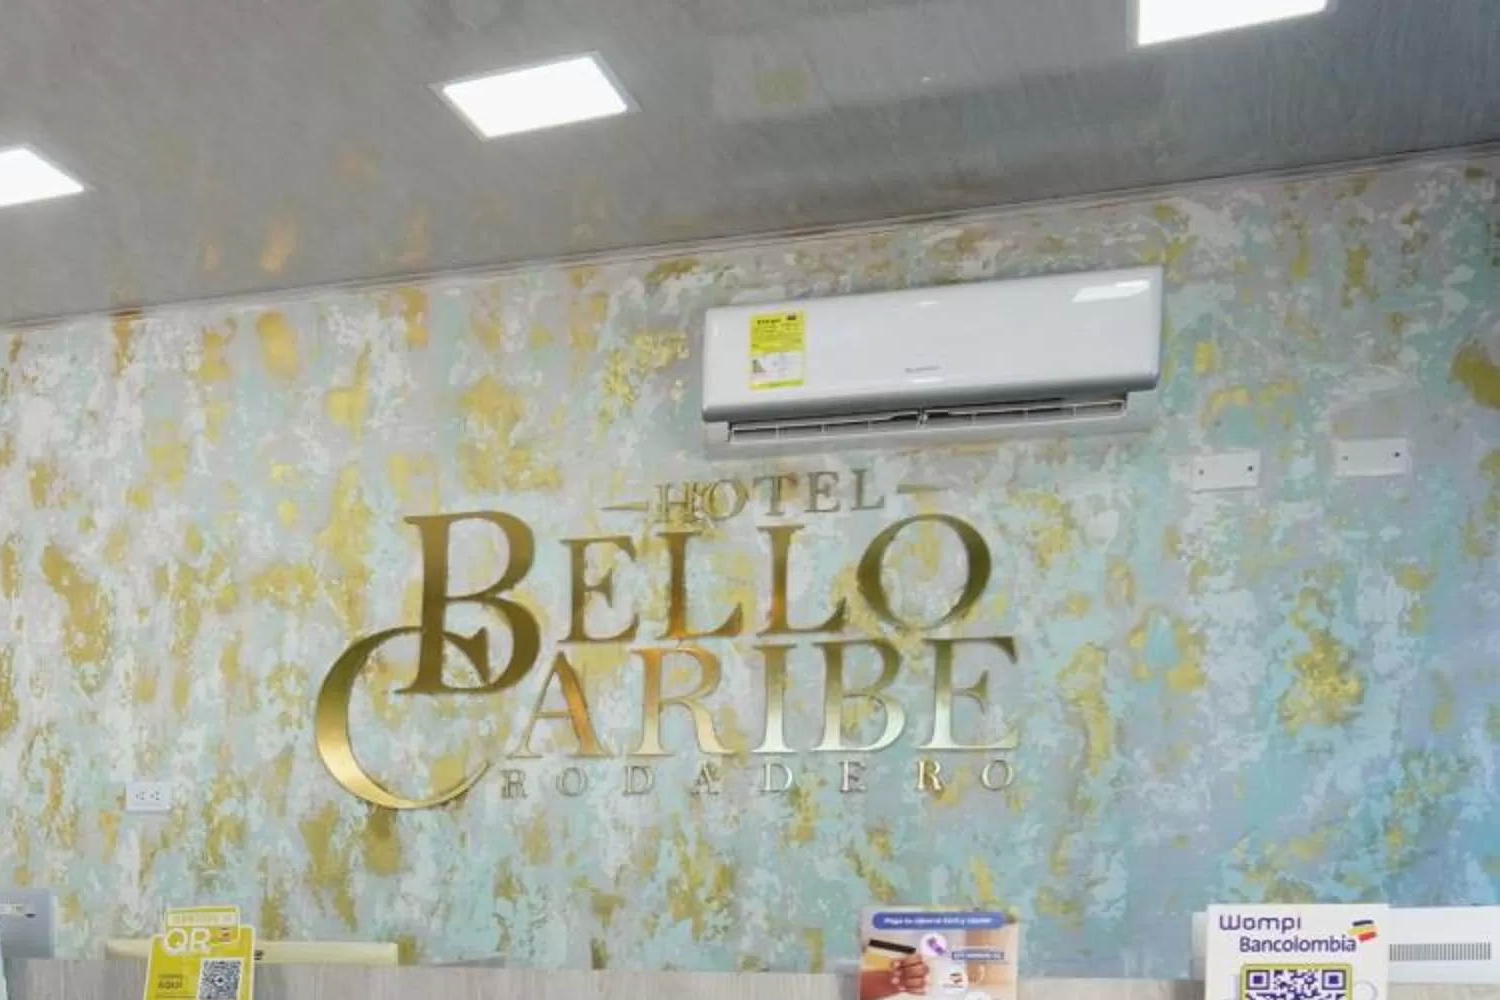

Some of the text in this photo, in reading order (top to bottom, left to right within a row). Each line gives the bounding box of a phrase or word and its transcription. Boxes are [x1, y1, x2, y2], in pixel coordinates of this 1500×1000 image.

[653, 467, 886, 523] HOTEL
[391, 509, 993, 695] BELLO
[315, 625, 1020, 810] CARIBE
[501, 757, 1015, 800] RODADERO
[163, 926, 212, 956] QR
[1218, 913, 1302, 932] Wompi
[1239, 934, 1357, 953] Bancolombia
